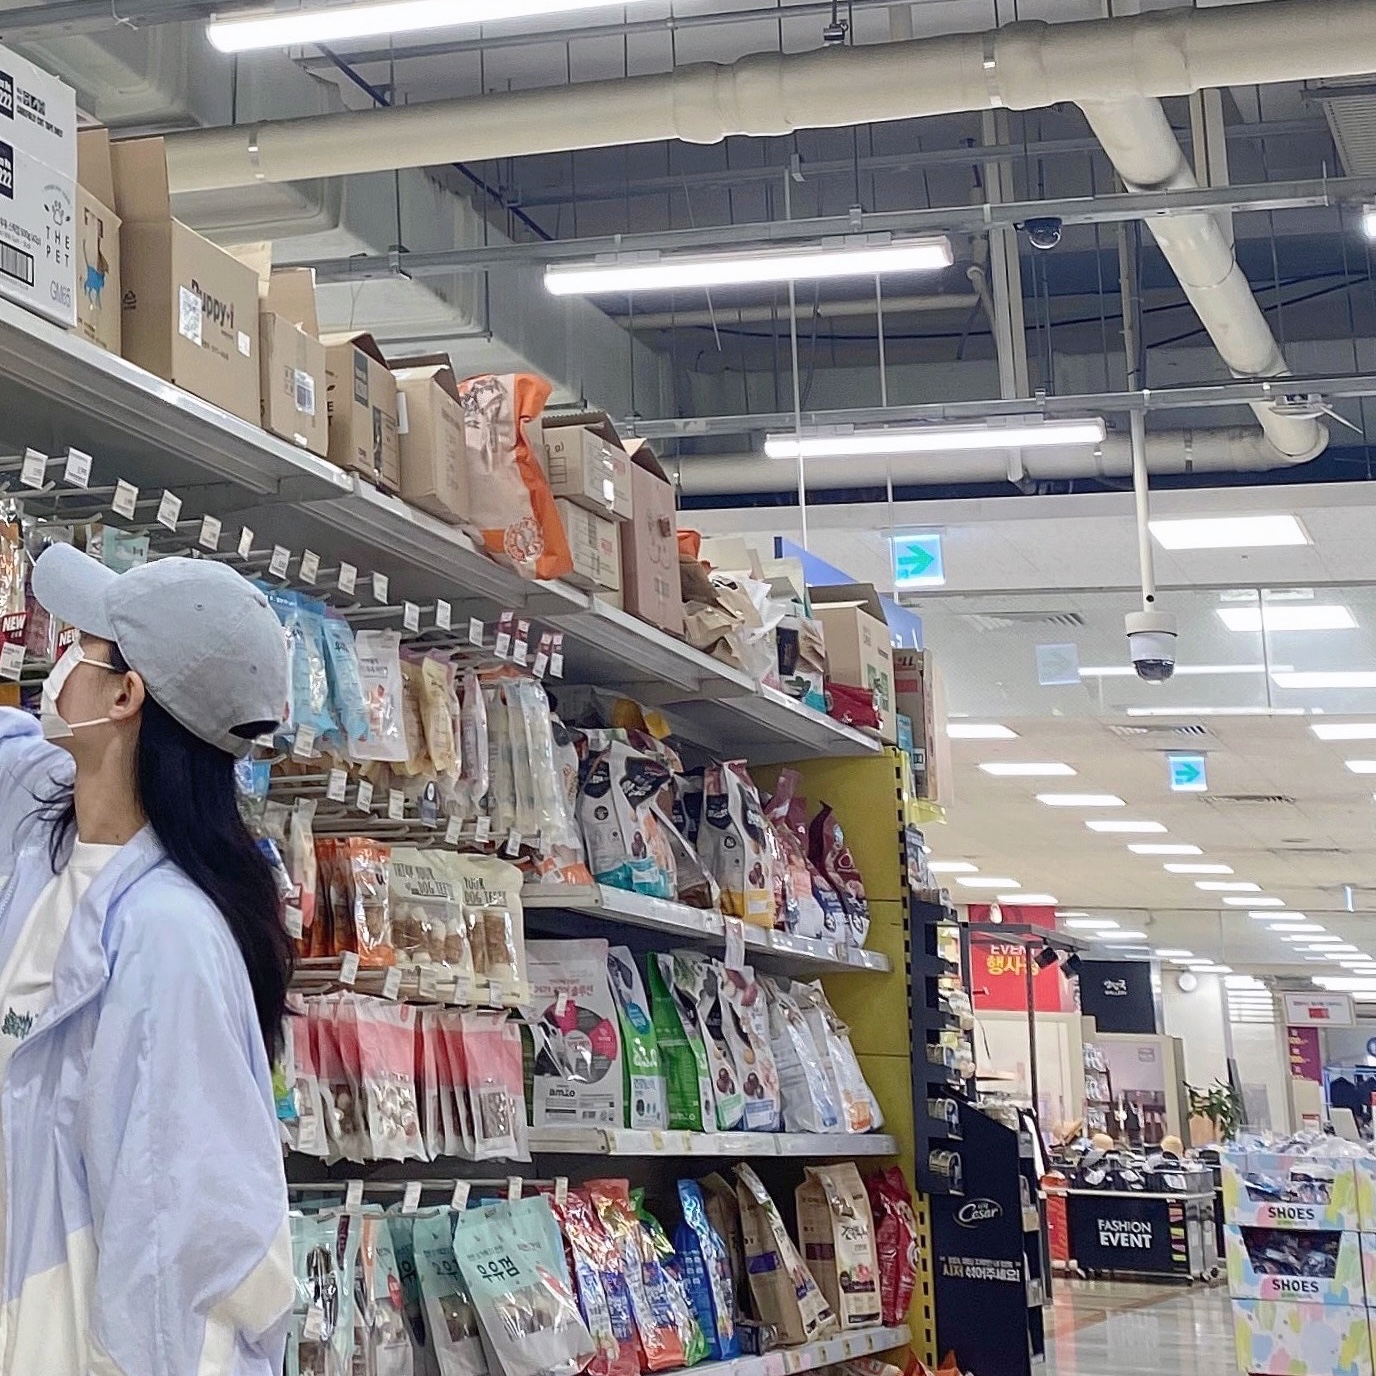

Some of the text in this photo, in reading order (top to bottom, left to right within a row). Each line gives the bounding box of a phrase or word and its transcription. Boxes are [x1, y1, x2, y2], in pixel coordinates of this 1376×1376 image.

[45, 225, 70, 250] THE
[45, 244, 70, 268] PET
[2, 614, 26, 633] NEW
[958, 1203, 999, 1223] Cesar
[1267, 1205, 1316, 1221] SHOES
[1097, 1218, 1152, 1235] FASHION
[1099, 1232, 1152, 1250] EVENT
[1271, 1278, 1320, 1294] SHOES
